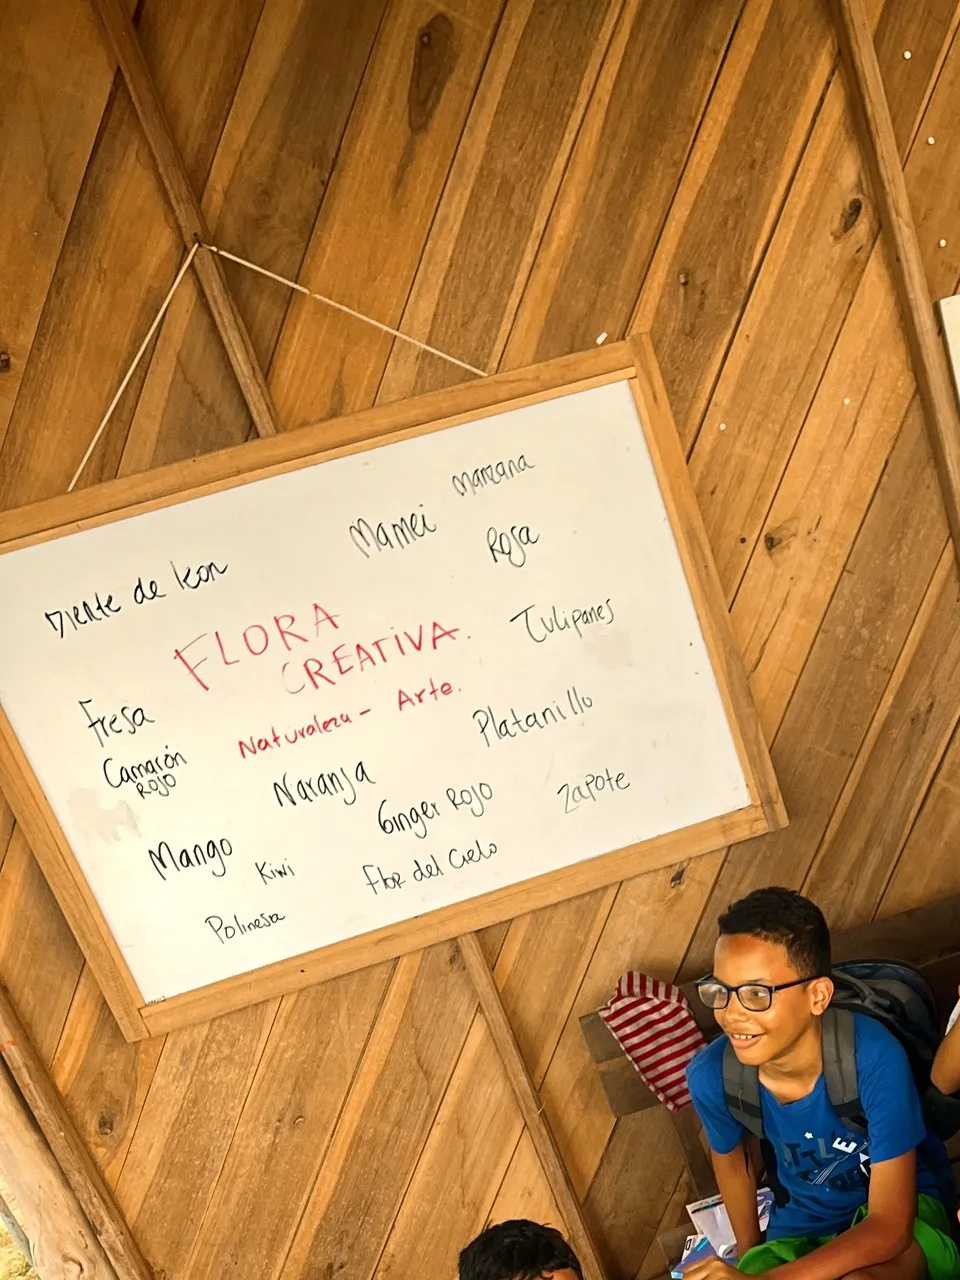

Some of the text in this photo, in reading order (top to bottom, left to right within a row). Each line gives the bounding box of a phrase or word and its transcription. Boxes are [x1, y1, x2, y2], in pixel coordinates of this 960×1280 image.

[133, 577, 167, 604] de
[509, 598, 615, 643] Tulipanes
[173, 603, 341, 691] FLORA
[78, 699, 156, 748] Fresa
[472, 686, 593, 748] Platanillo
[148, 838, 233, 881] Mango
[254, 858, 295, 886] Kiwi
[412, 855, 444, 883] del
